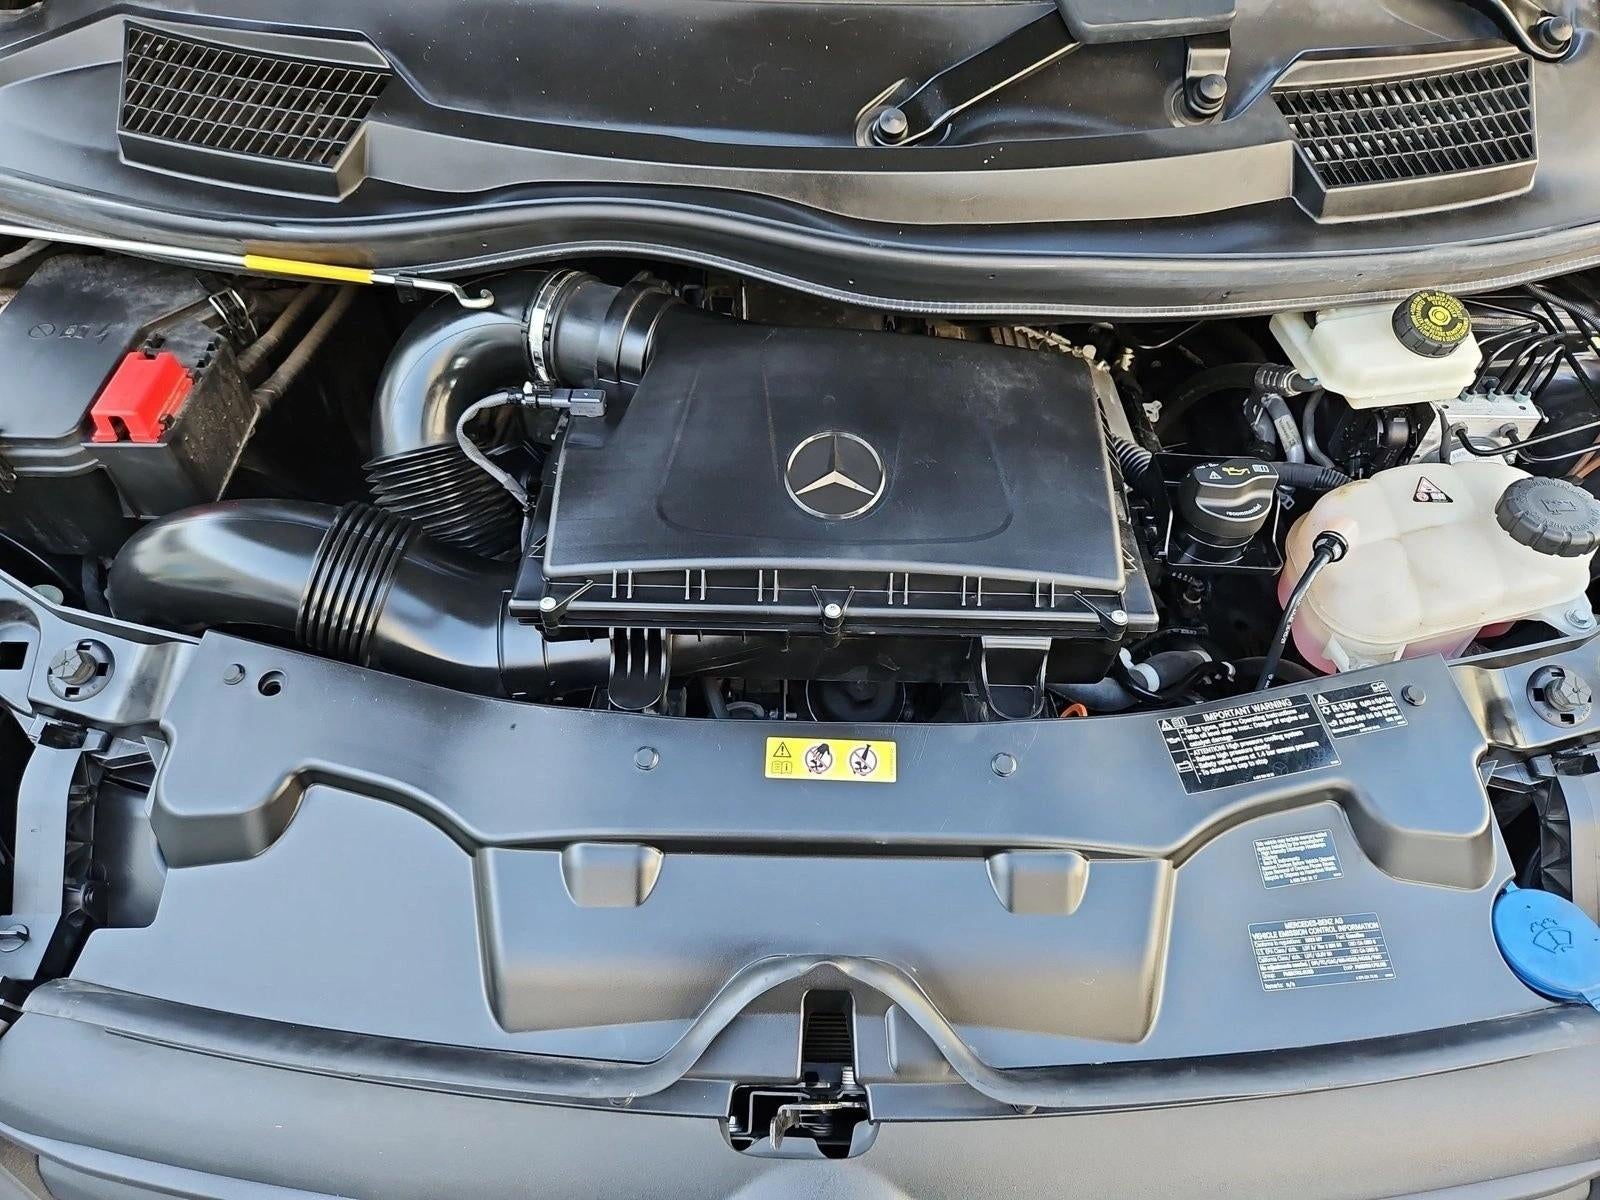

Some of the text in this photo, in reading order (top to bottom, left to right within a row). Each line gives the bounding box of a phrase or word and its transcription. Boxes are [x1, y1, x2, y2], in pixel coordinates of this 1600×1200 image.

[1201, 698, 1293, 722] IMPORTANT WARNING
[1329, 700, 1358, 713] R-134a
[1251, 920, 1379, 940] VEHICLE EMISSION CONTROL INFORMATION
[1283, 918, 1334, 929] MERCEDES-BENZ
